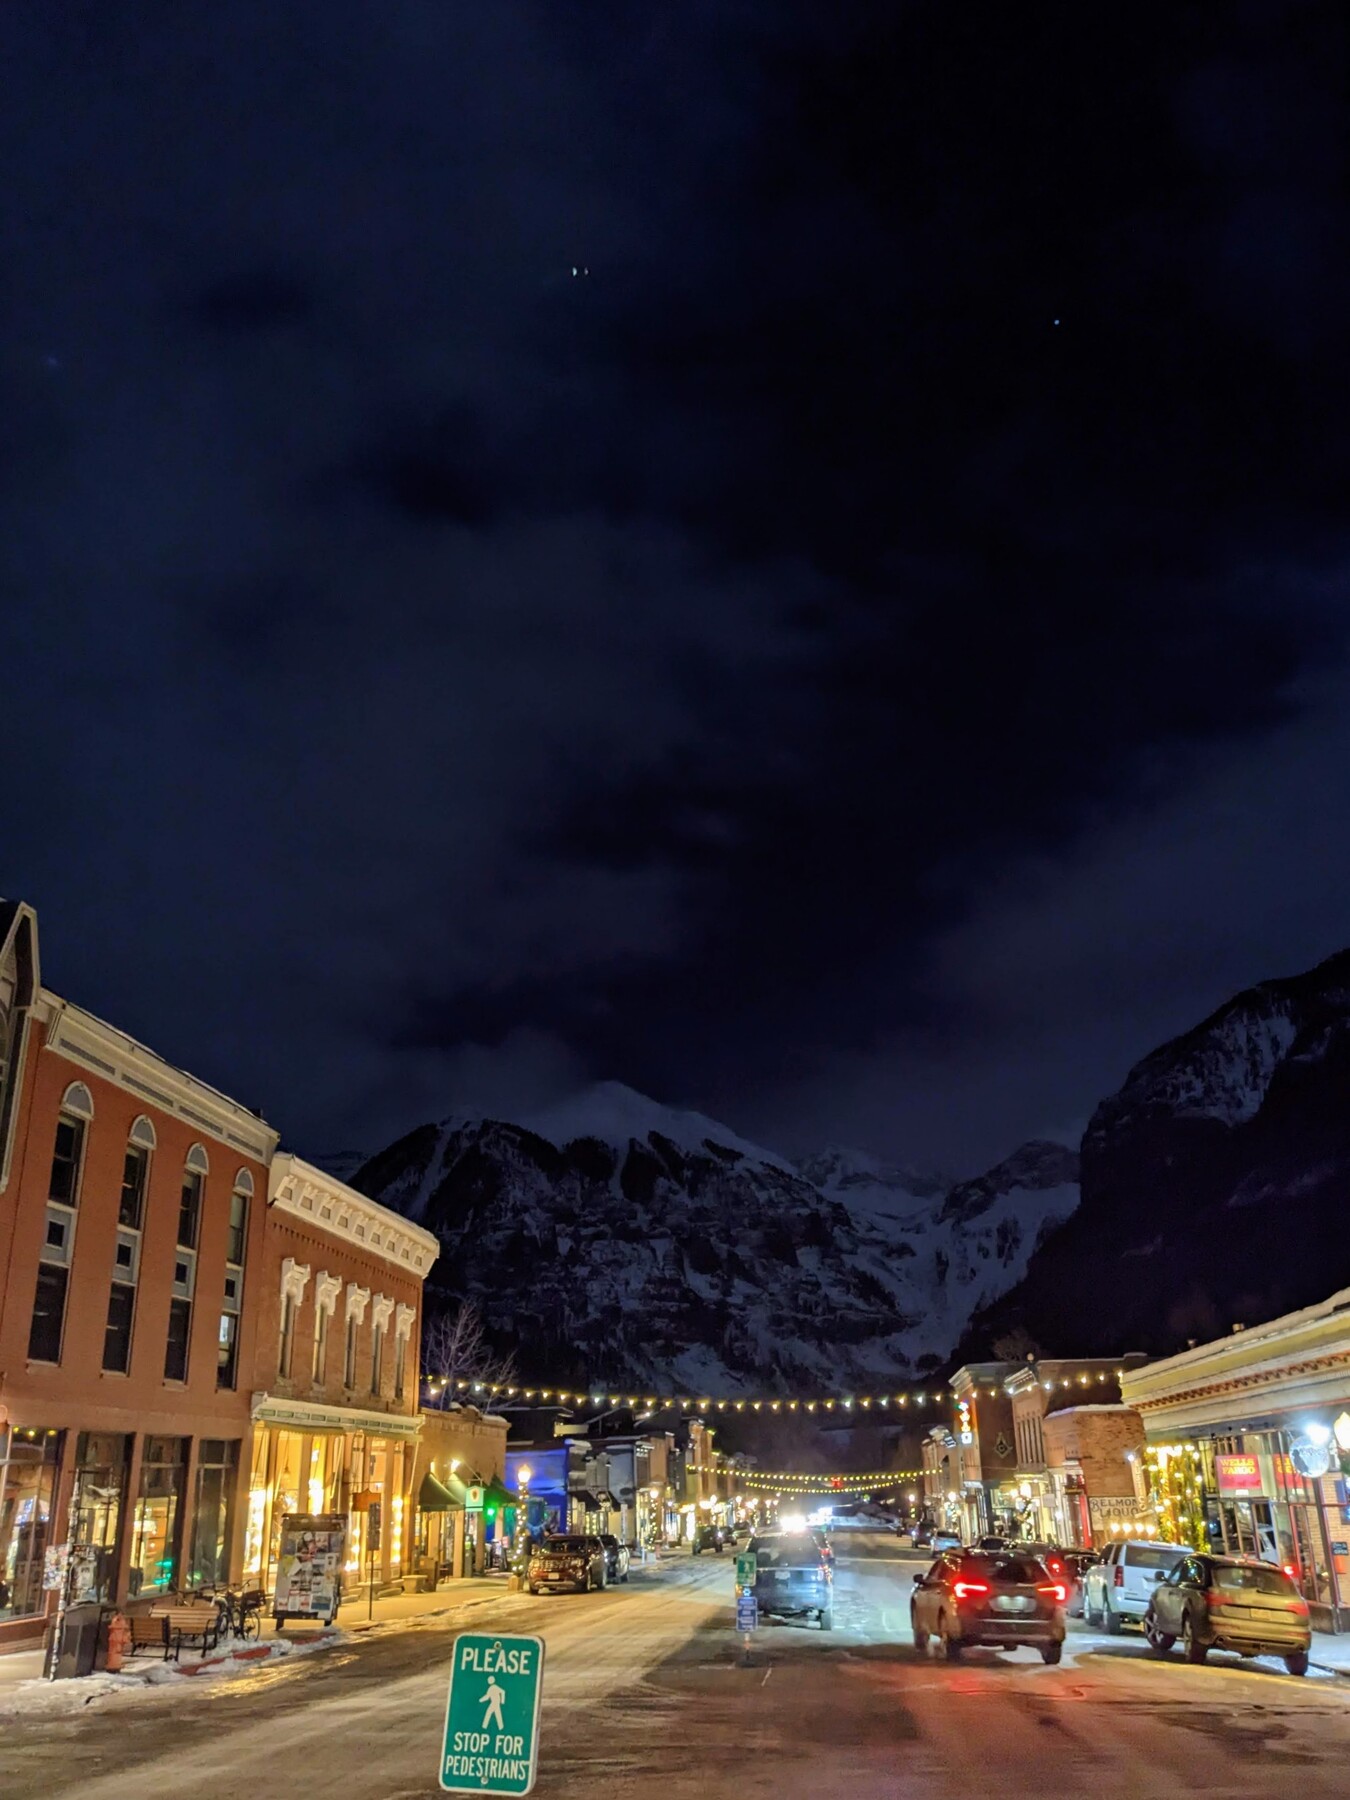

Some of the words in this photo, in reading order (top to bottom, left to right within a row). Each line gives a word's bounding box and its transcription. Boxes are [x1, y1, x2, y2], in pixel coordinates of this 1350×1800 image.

[1219, 1458, 1254, 1466] WELLS
[1222, 1466, 1255, 1475] FARGO
[1090, 1498, 1138, 1512] BELMON
[1100, 1507, 1139, 1518] LIQUO
[461, 1647, 531, 1675] PLEASE
[453, 1731, 490, 1753] STOP
[495, 1735, 523, 1756] FOR
[445, 1755, 526, 1780] PEDESTRIANS
